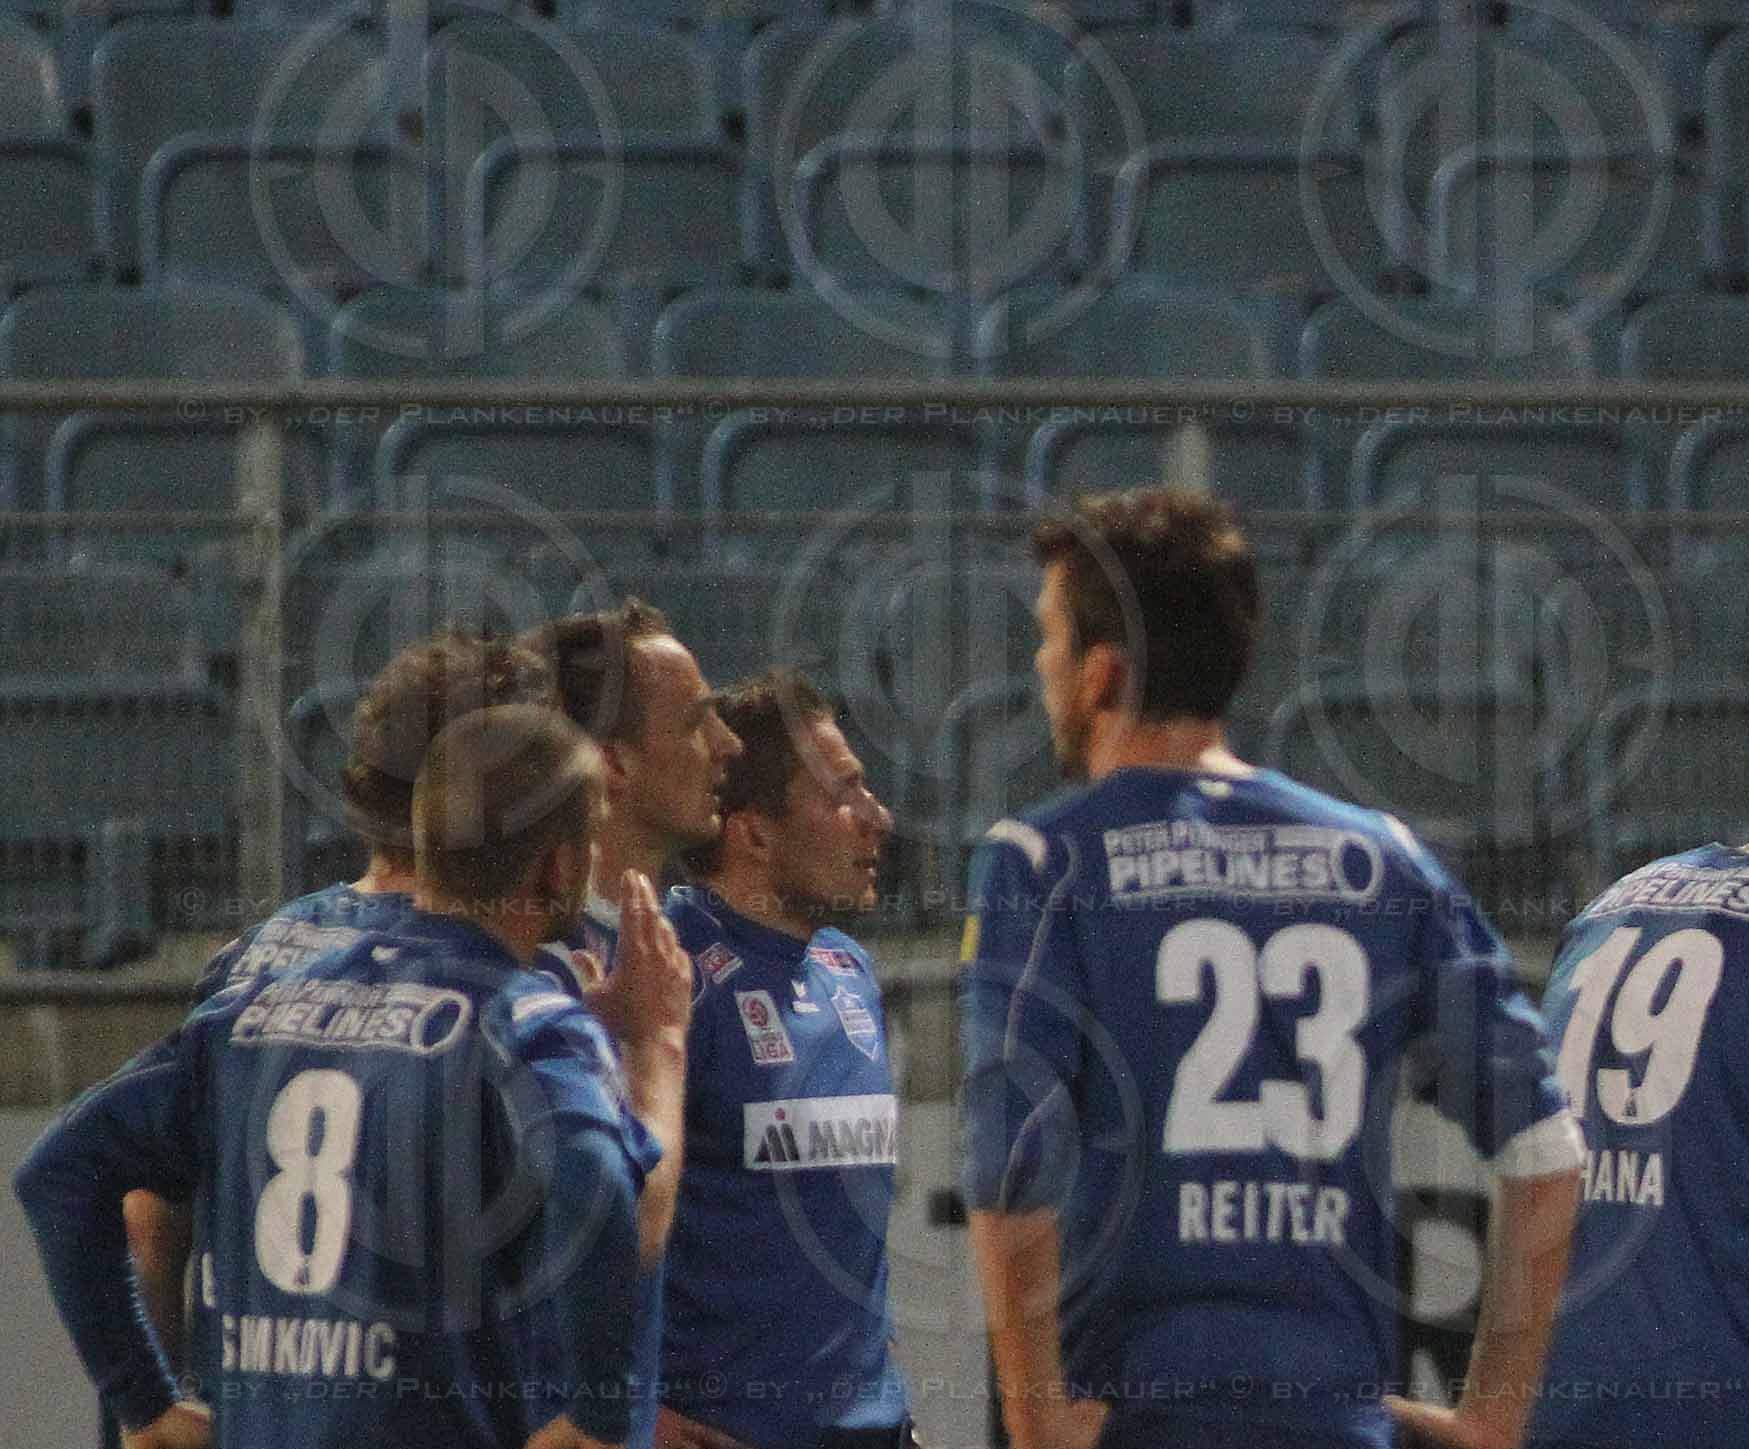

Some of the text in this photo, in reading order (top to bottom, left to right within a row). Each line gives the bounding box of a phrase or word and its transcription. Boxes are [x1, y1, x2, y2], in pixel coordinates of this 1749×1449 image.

[1156, 918, 1370, 1160] 23
[1557, 927, 1724, 1126] 19
[254, 1067, 364, 1297] 8
[1178, 1178, 1350, 1245] REITER
